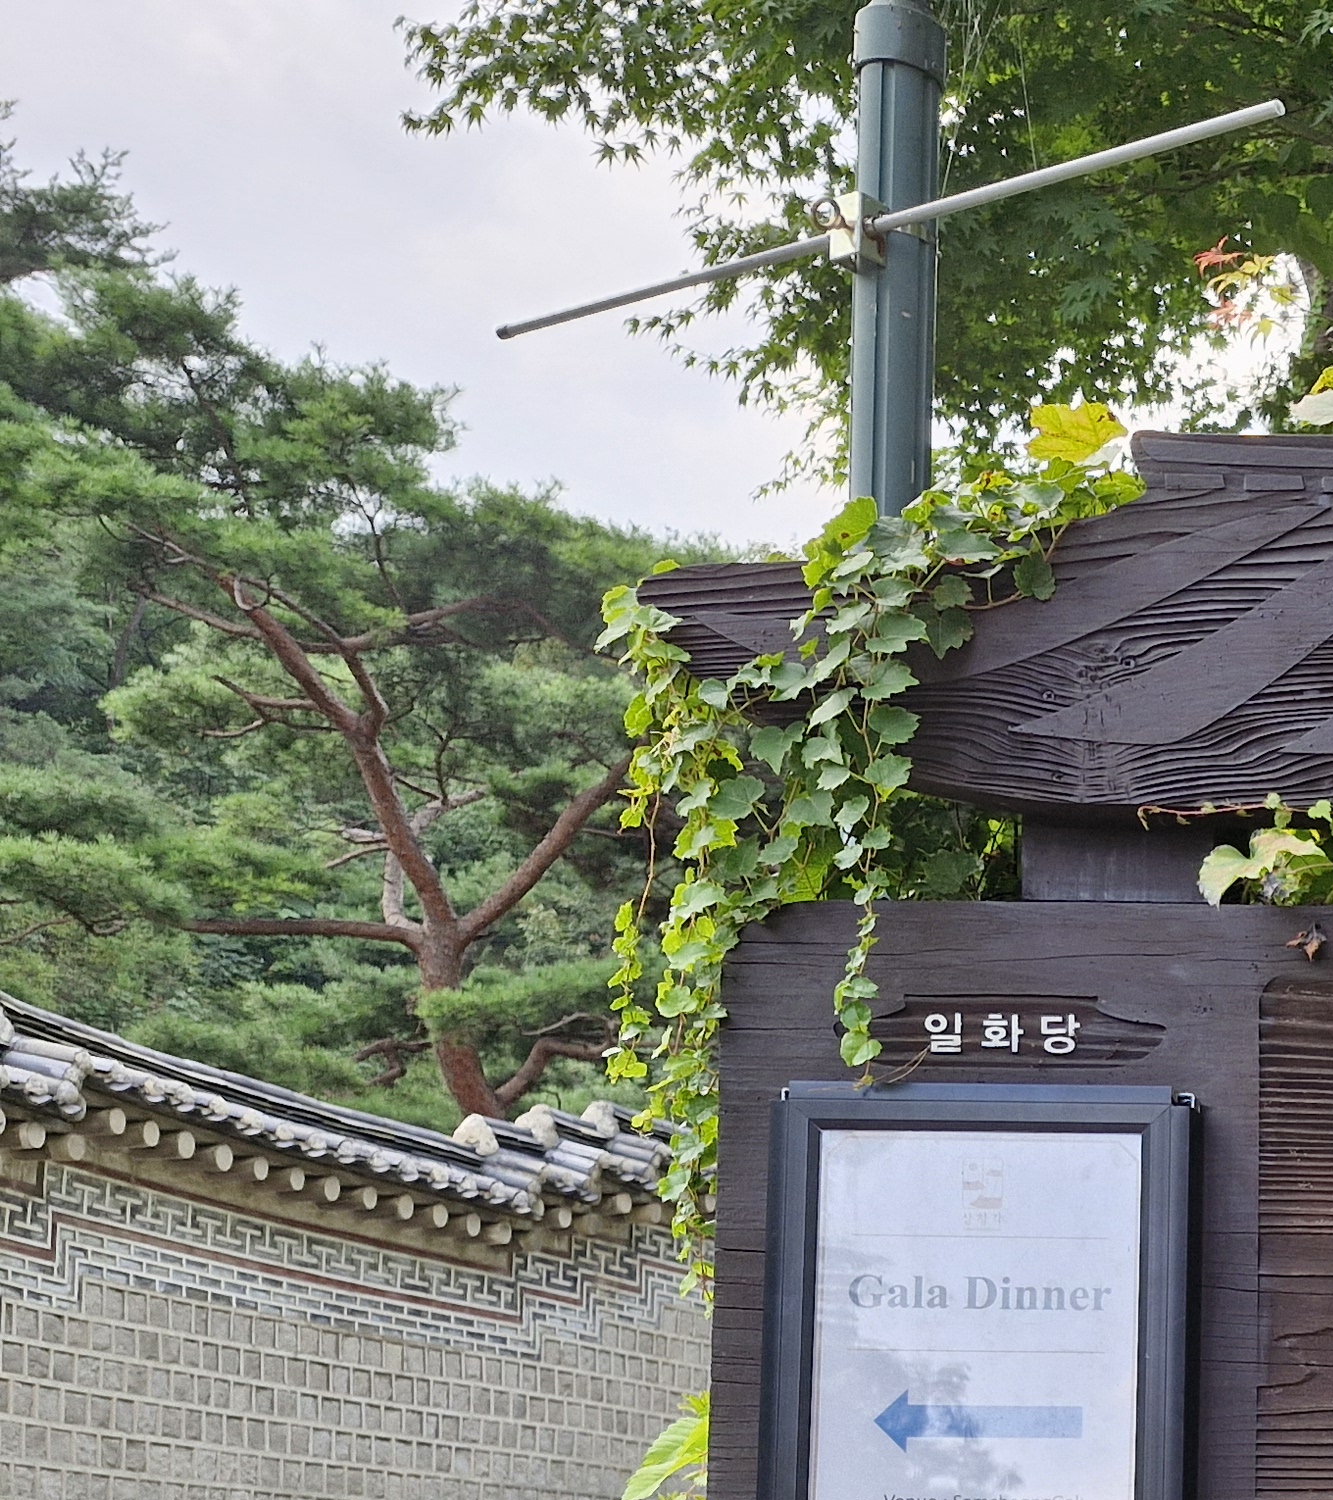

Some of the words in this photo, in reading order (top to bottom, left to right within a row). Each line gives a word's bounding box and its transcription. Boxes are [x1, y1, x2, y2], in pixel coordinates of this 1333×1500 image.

[925, 1013, 1080, 1053] 일화당
[848, 1275, 950, 1311] Gala
[964, 1275, 1112, 1312] Dinner
